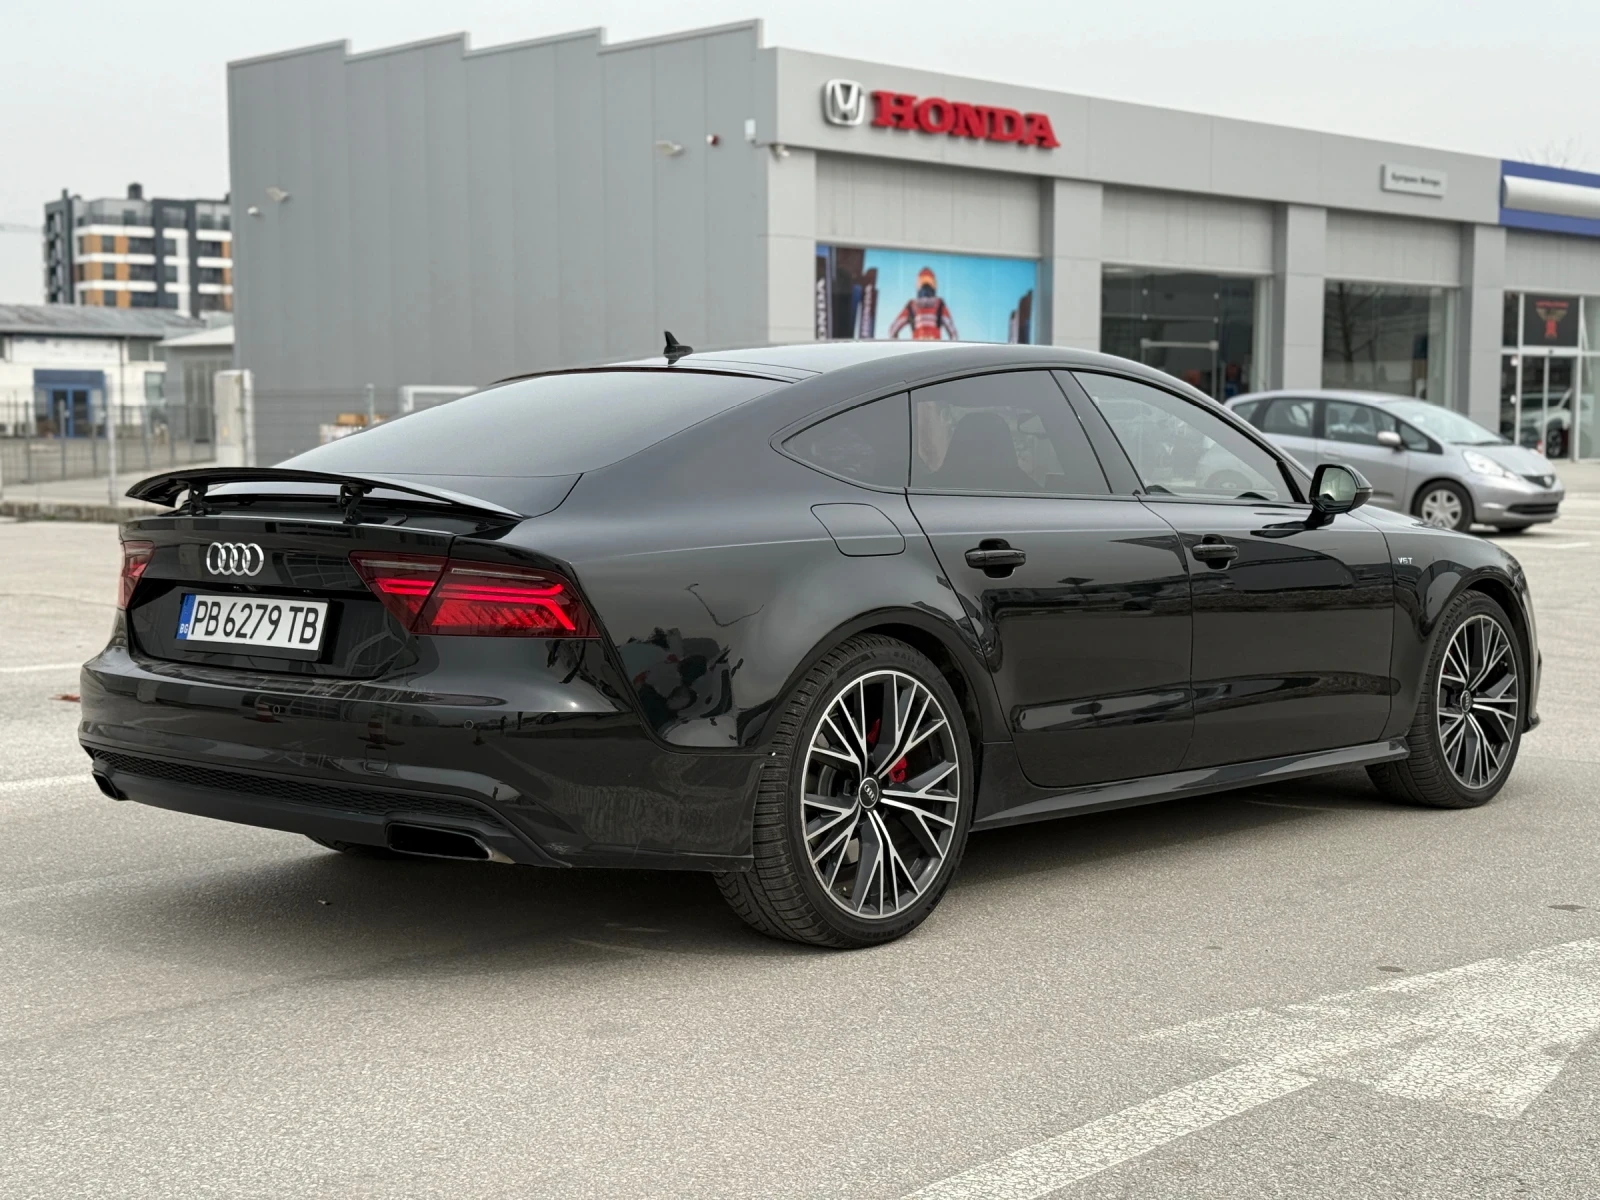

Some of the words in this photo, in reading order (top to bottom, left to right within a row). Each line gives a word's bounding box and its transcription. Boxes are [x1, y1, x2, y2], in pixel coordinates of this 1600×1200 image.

[871, 90, 1061, 149] HONDA
[817, 277, 827, 340] ONDA
[179, 623, 189, 634] BG
